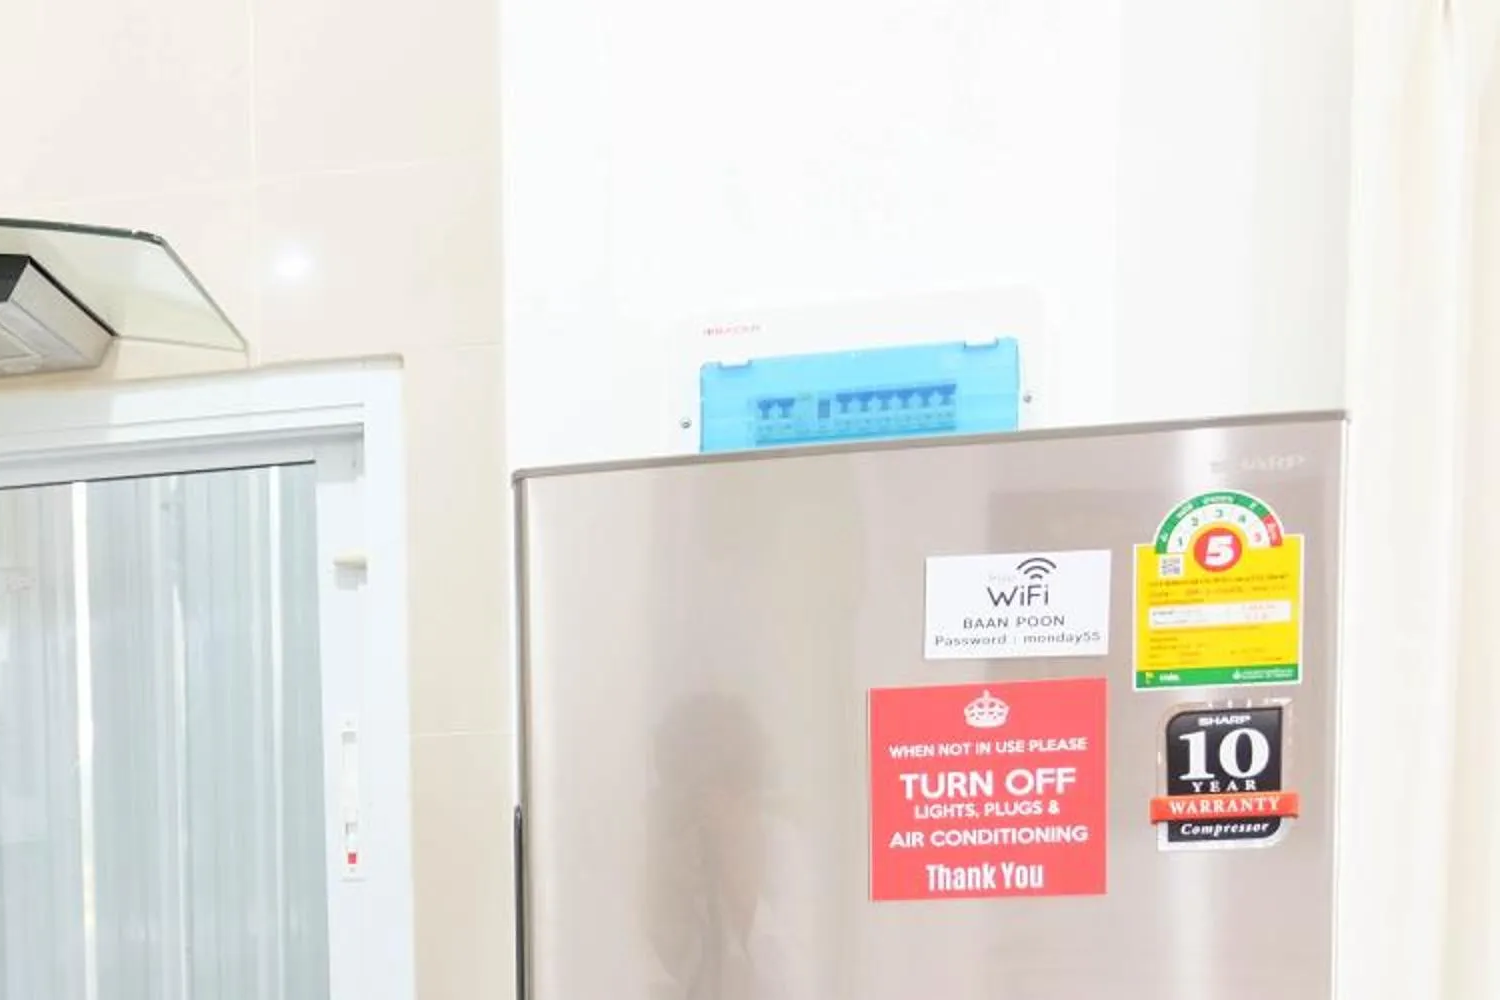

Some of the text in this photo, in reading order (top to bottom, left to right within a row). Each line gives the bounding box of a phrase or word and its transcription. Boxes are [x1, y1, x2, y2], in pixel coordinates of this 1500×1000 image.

[1204, 534, 1235, 567] 5
[987, 584, 1049, 607] WiFi
[963, 615, 1065, 629] BAAN POON
[935, 634, 1007, 648] Password
[1198, 715, 1251, 726] SHARP
[890, 737, 1088, 758] WHEN NOT IN USE PLEASE
[1178, 728, 1270, 781] 10
[900, 767, 1076, 799] TURN OFF
[1192, 780, 1257, 792] YEAR
[984, 800, 1042, 817] PLUGS
[1047, 800, 1060, 815] &
[1169, 798, 1281, 814] WARRANTY
[889, 825, 1089, 848] AIR CONDITIONING
[1180, 822, 1270, 837] Compressor
[926, 862, 1045, 891] Thank You
